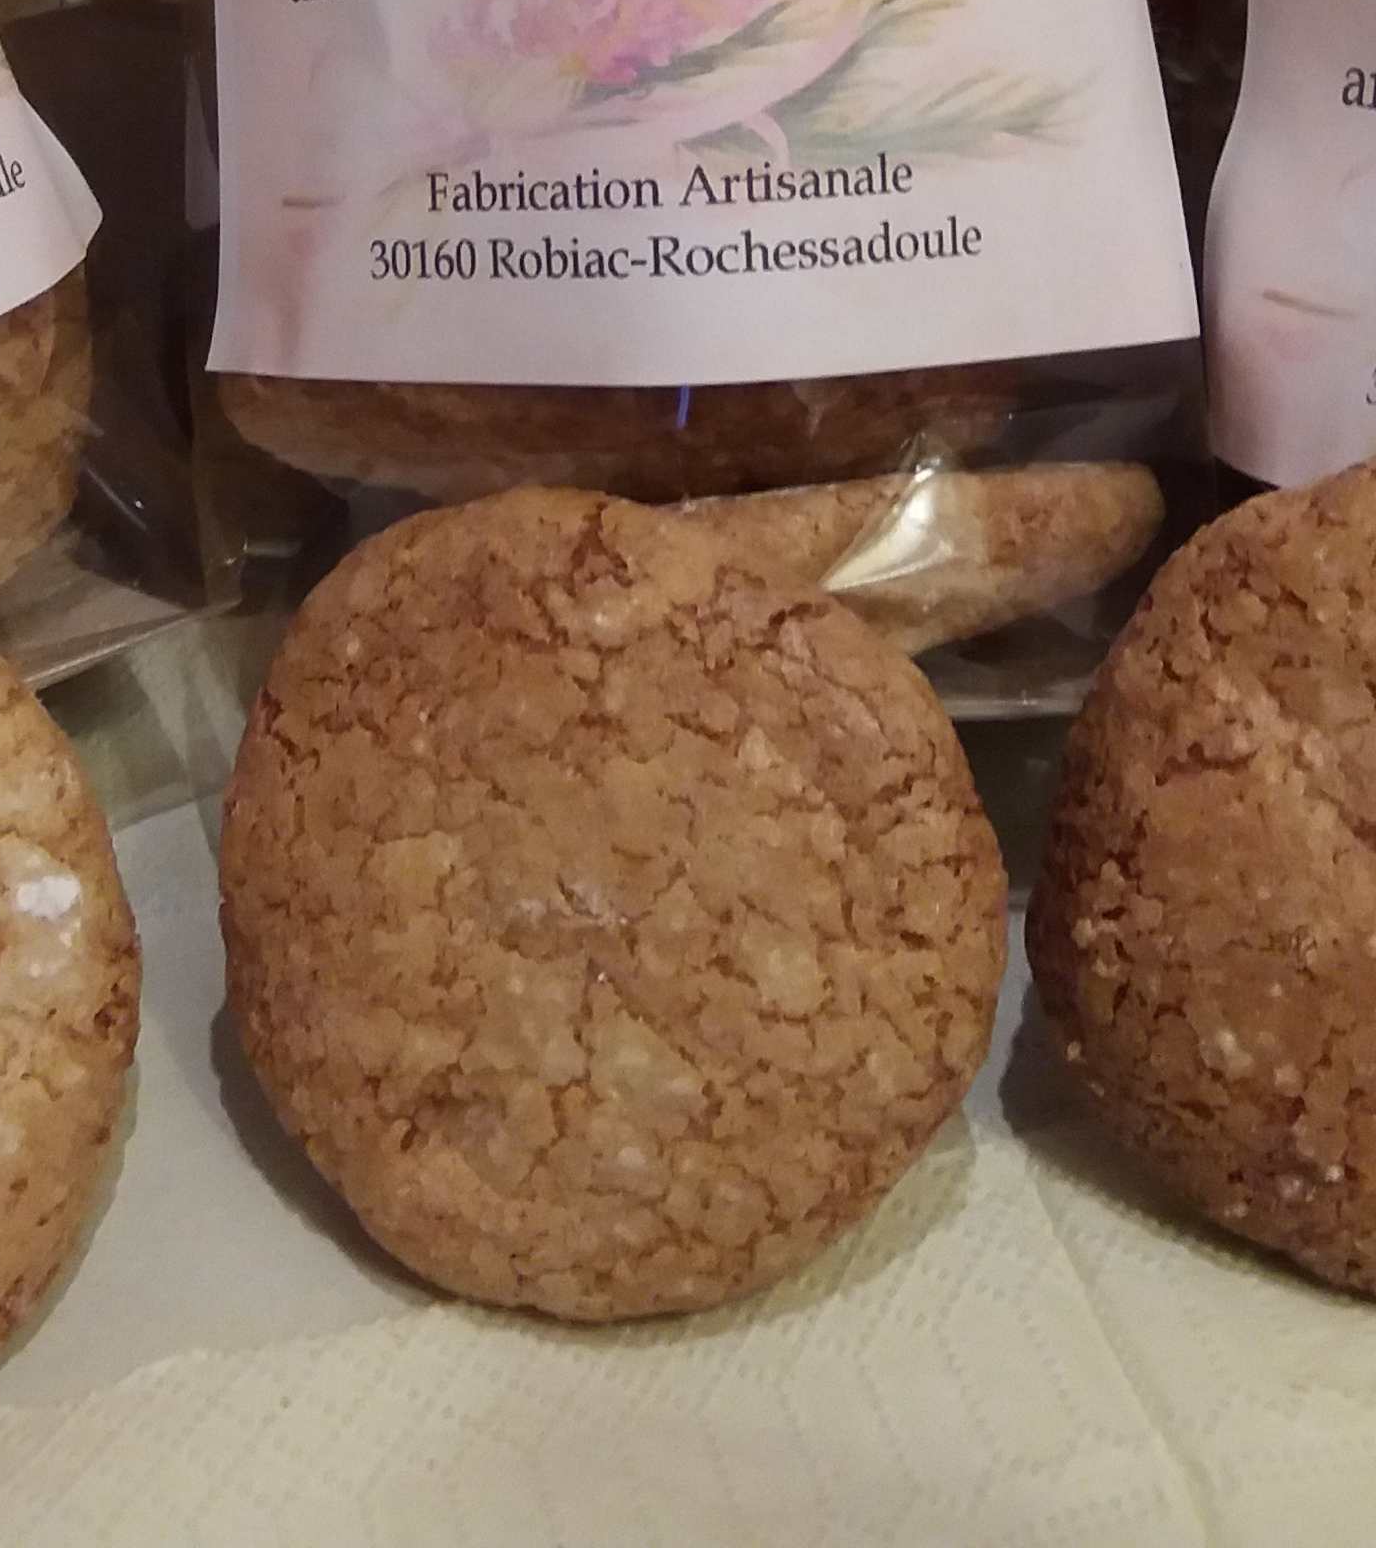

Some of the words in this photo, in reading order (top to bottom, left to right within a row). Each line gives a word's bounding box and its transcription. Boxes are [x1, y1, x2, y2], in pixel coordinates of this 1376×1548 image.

[427, 168, 661, 213] Fabrication
[680, 152, 912, 205] Artisanale
[371, 239, 475, 279] 30160
[489, 216, 981, 278] Robiac-Rochessadoule
